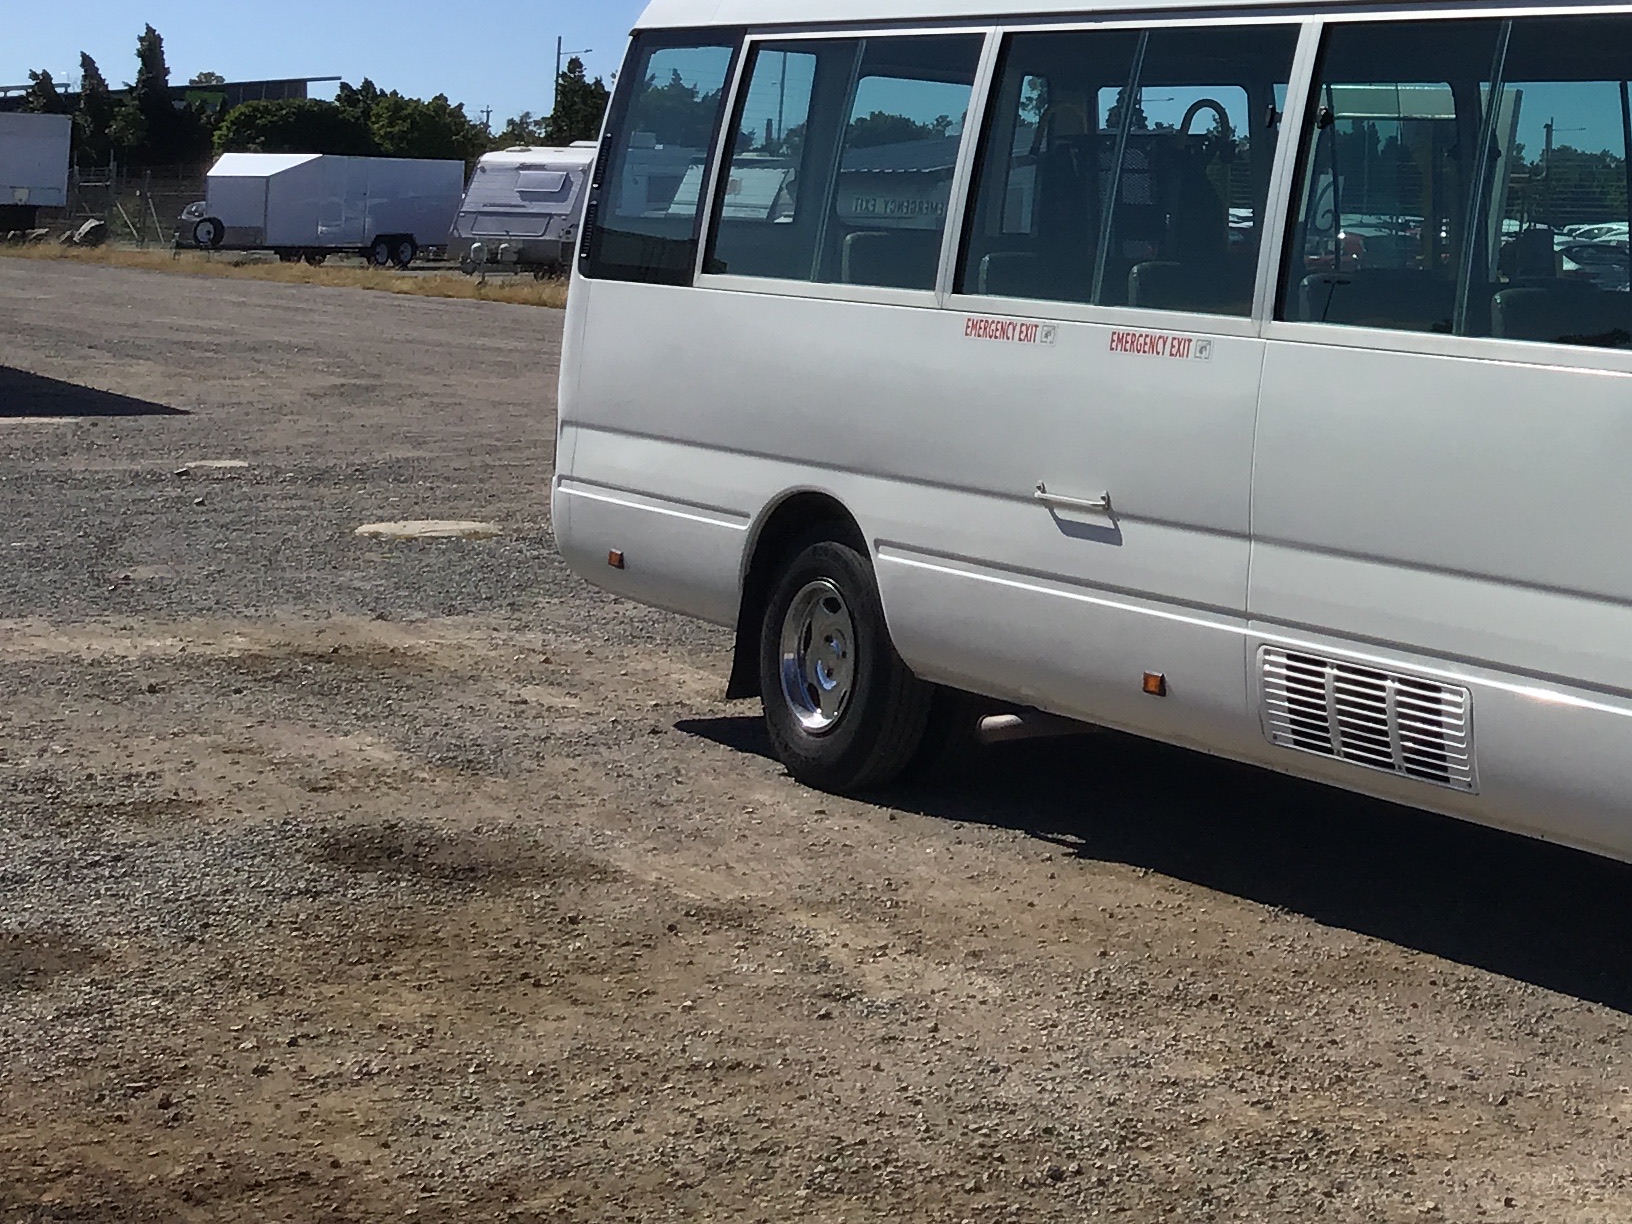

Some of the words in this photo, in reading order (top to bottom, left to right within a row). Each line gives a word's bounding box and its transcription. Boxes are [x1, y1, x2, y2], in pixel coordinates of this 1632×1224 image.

[964, 317, 1018, 342] EMERGENCY
[1018, 322, 1039, 343] EXIT
[1109, 331, 1169, 356] EMERGENCY
[1168, 336, 1193, 359] EXIT
